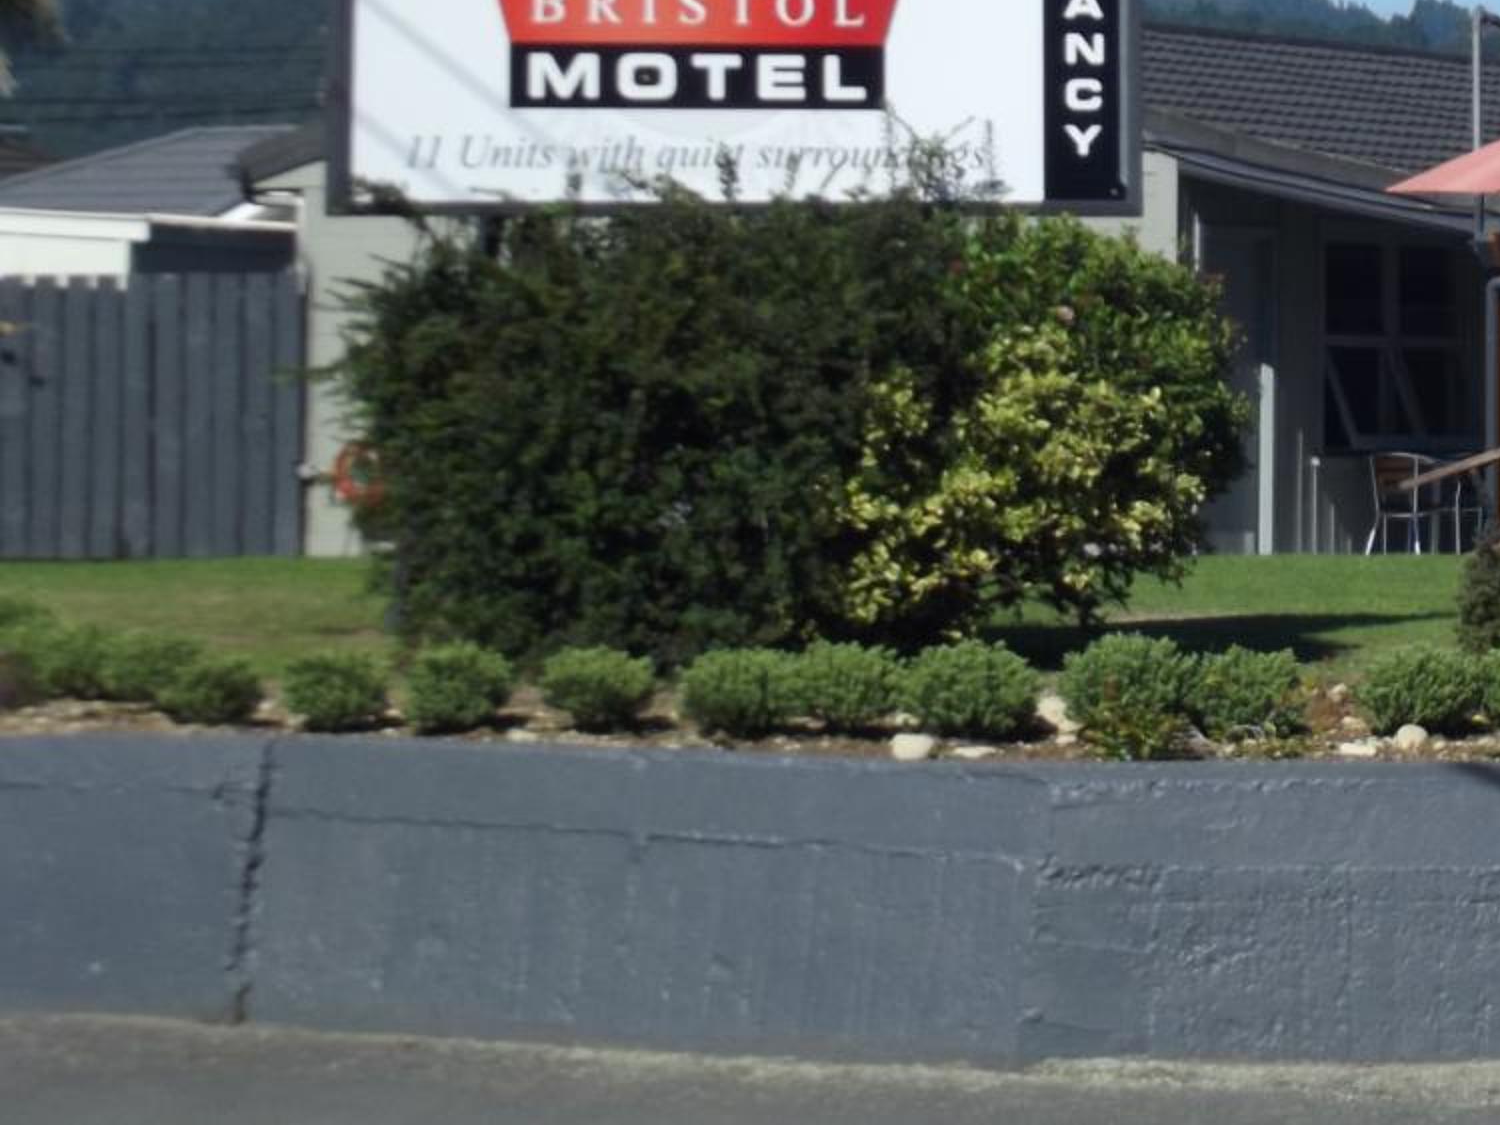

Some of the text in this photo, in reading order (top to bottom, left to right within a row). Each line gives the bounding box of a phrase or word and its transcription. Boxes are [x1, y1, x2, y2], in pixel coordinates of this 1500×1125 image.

[525, 51, 868, 102] MOTEL
[460, 134, 554, 169] Units
[655, 136, 744, 177] quit
